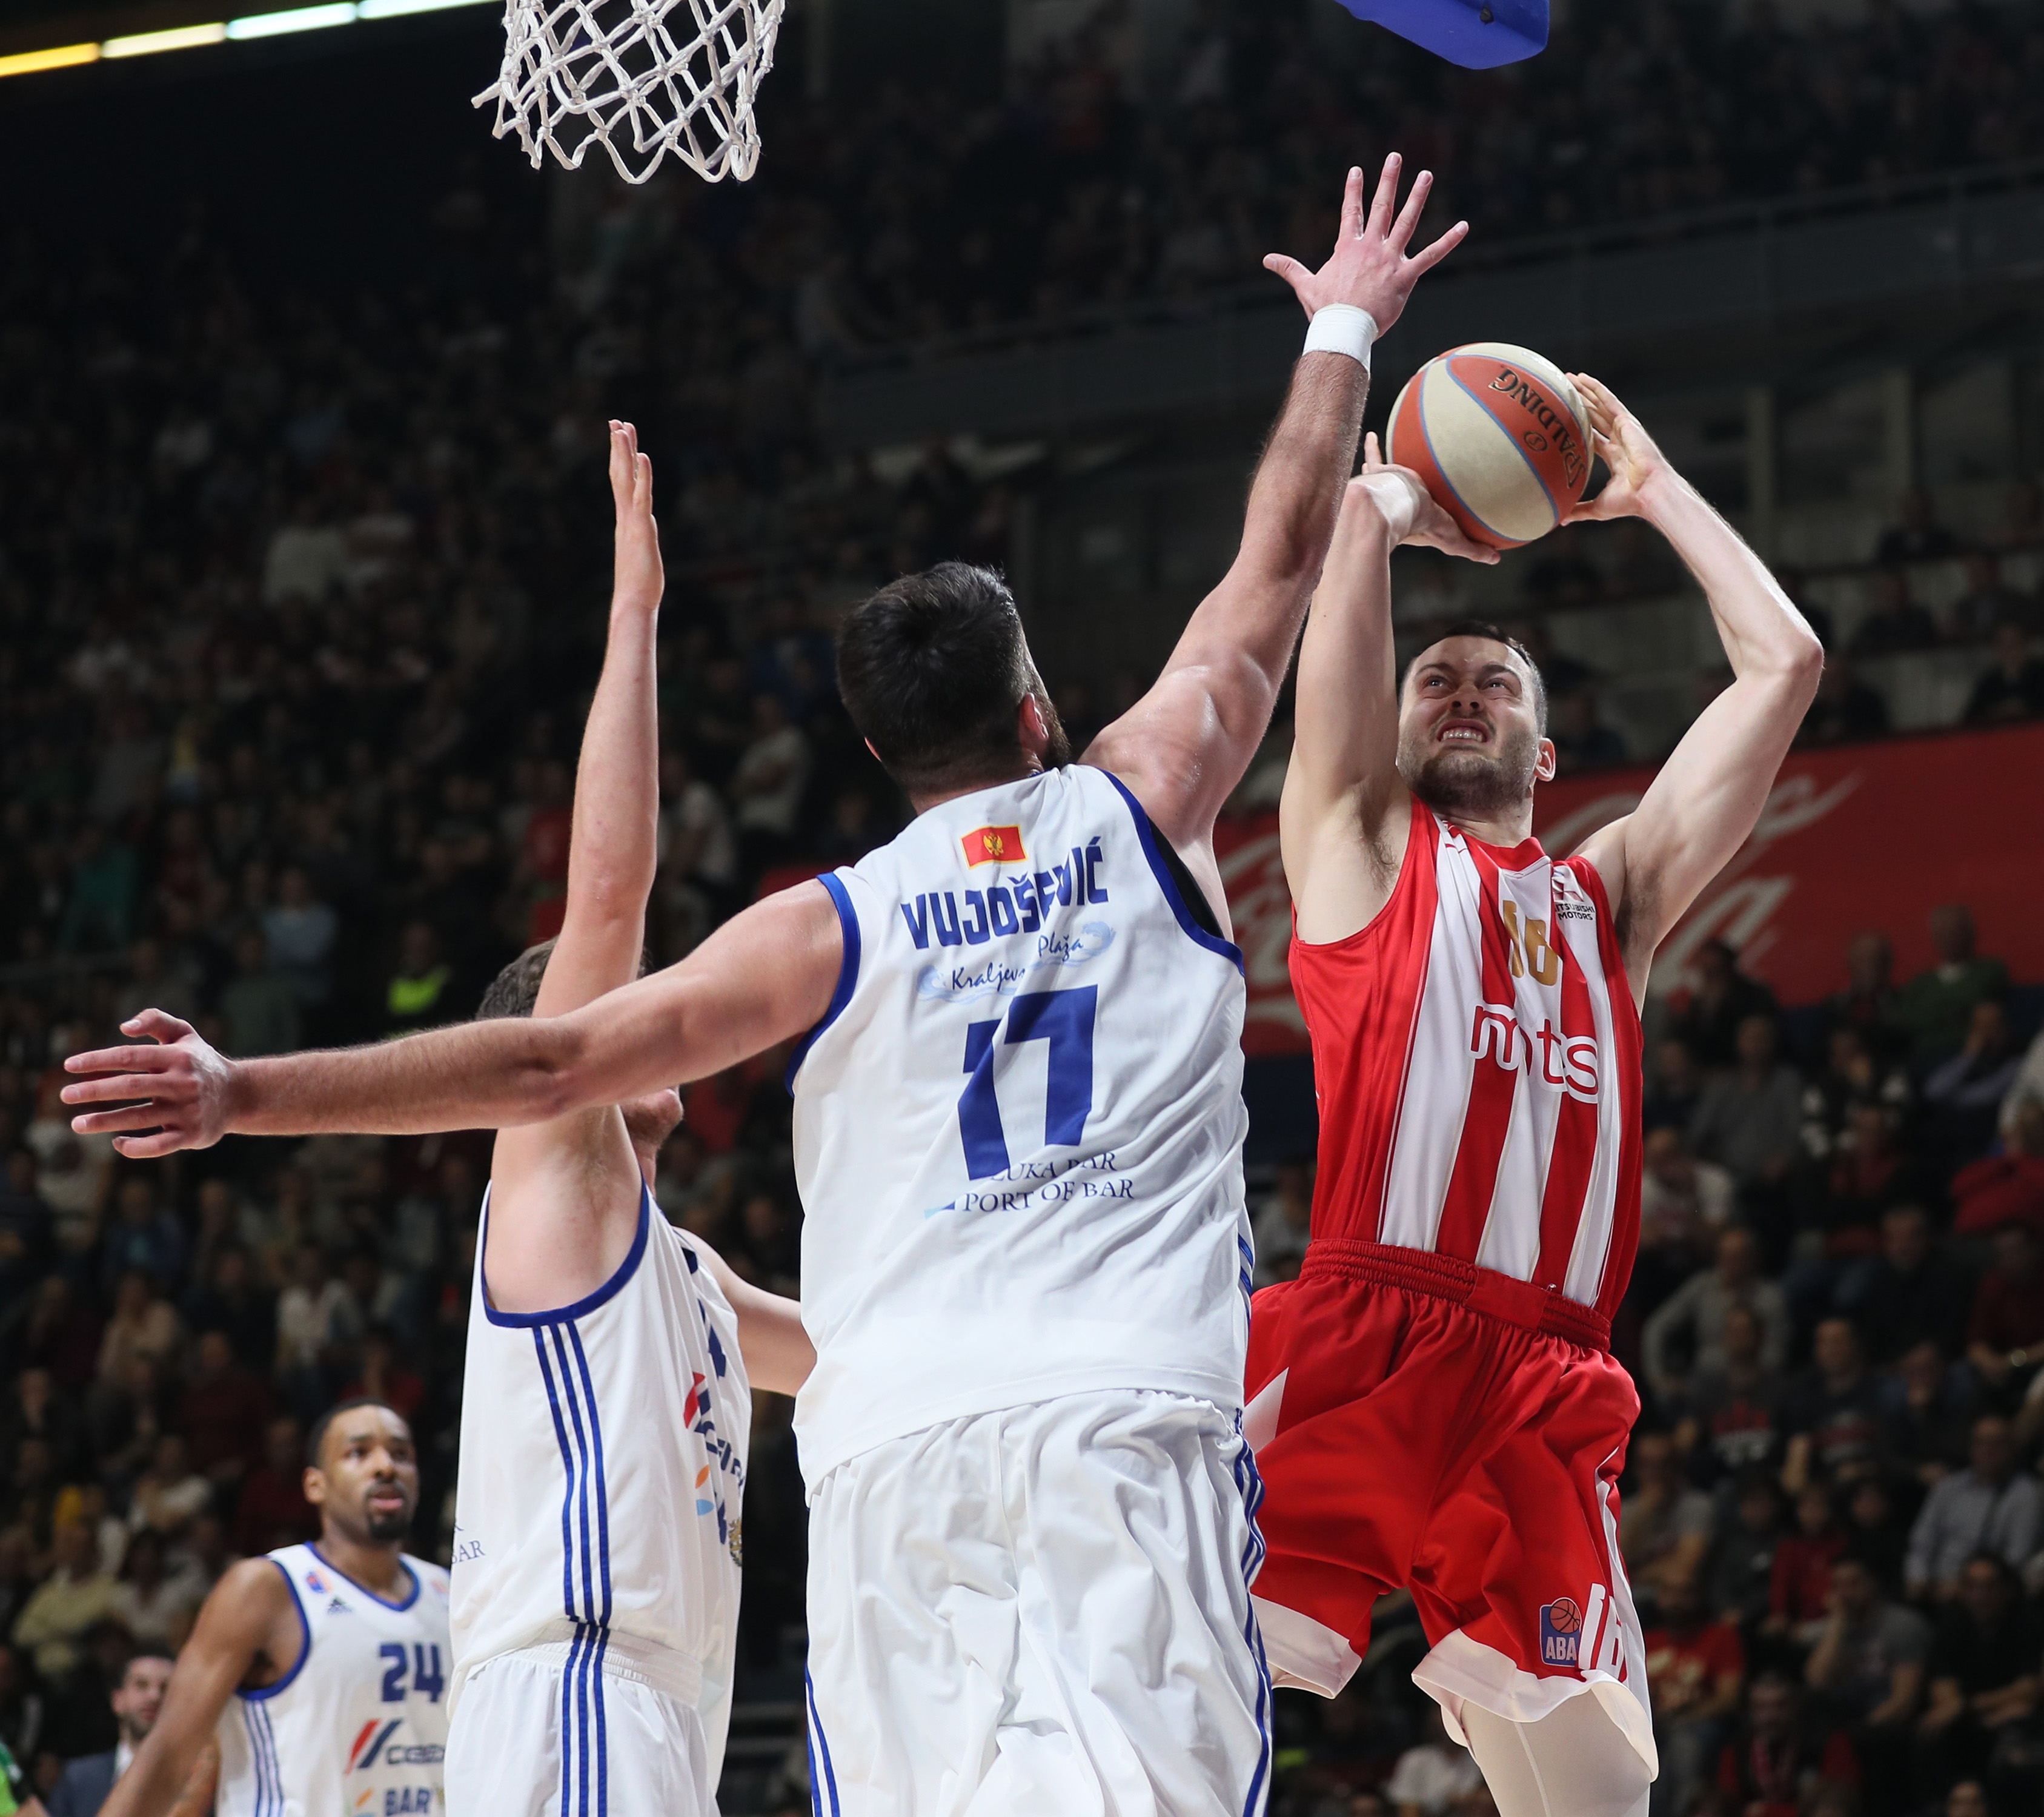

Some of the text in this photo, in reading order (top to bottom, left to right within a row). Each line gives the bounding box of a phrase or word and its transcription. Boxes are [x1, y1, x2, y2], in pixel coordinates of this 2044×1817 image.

[1488, 367, 1586, 489] SPALDING
[900, 836, 1109, 950] VUJOŠEVIĆ
[1555, 903, 1595, 913] ITSUBISHI
[1558, 911, 1593, 921] MOTORS
[1038, 932, 1083, 962] Plaža
[1468, 1004, 1599, 1099] mts
[957, 984, 1098, 1181] 17
[963, 1179, 1135, 1212] PORT OF BAR
[1545, 1637, 1577, 1661] ABA
[378, 1643, 444, 1703] 24
[385, 1786, 431, 1817] BAR
